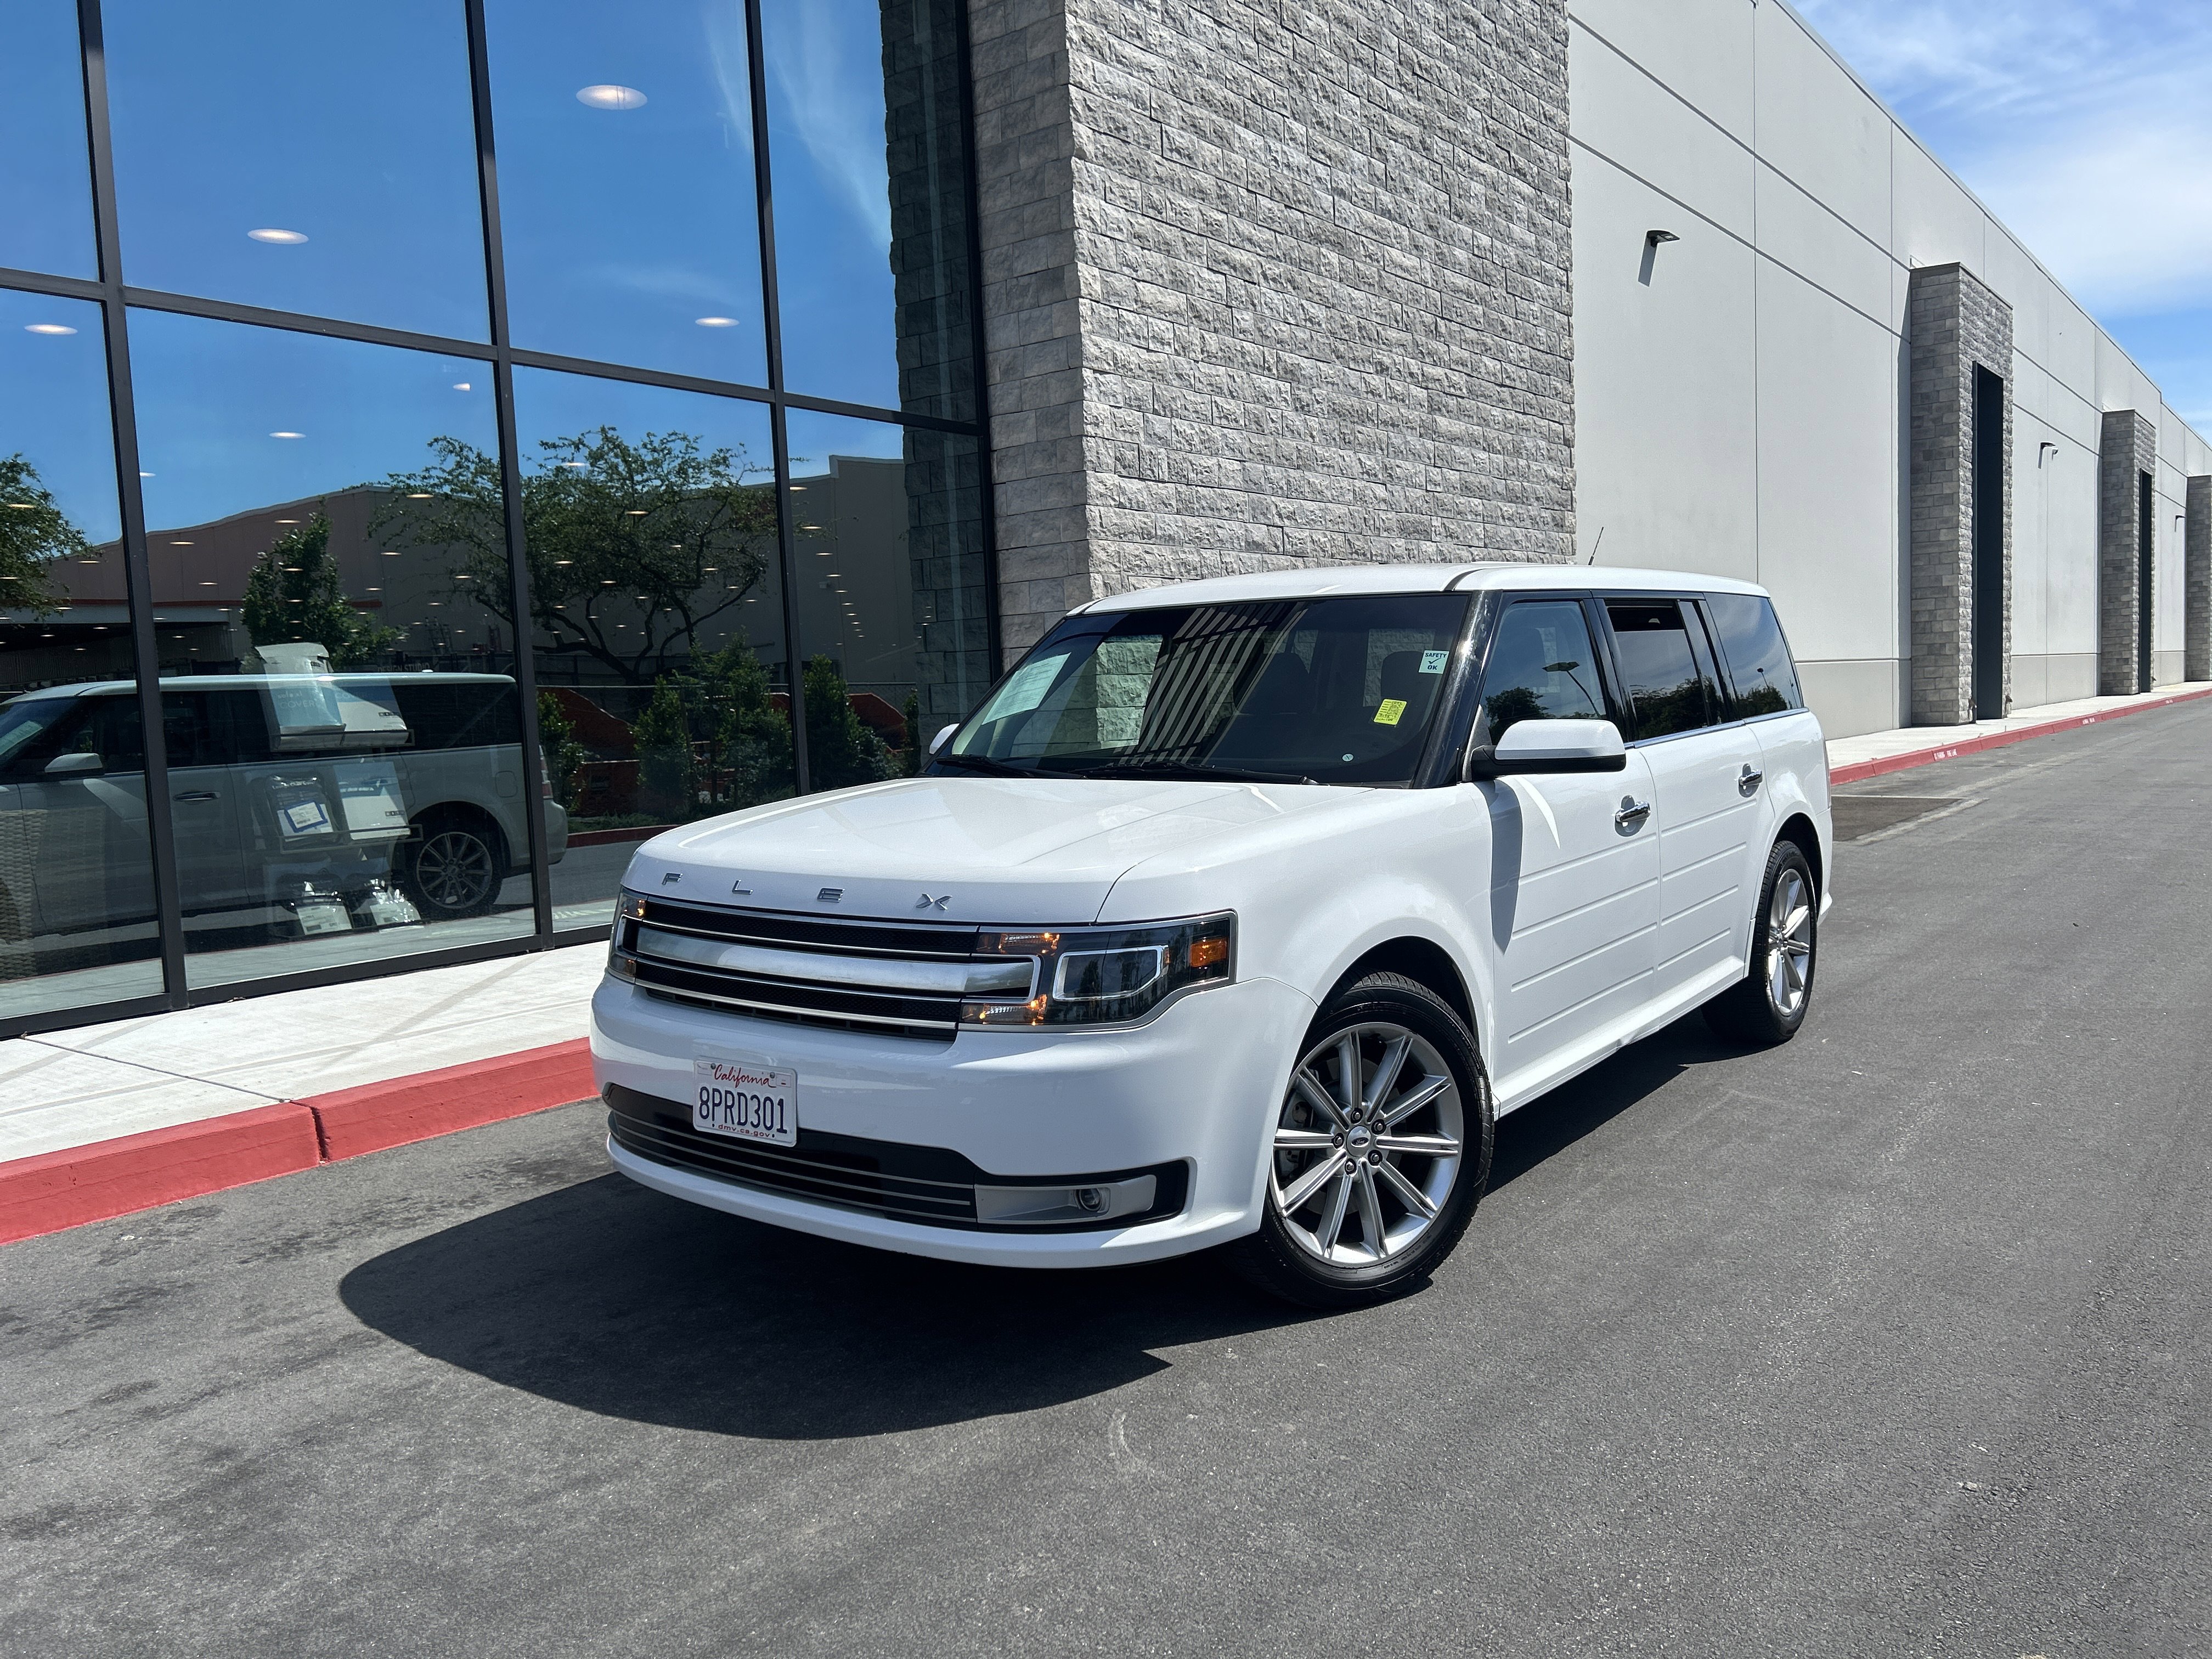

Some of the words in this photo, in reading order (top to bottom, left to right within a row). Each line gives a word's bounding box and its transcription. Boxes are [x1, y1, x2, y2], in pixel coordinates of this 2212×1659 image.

[404, 662, 430, 672] STUDIO
[280, 699, 315, 709] COVER
[662, 872, 952, 910] FLEX
[714, 1064, 776, 1088] California
[699, 1086, 787, 1133] 8PRD301
[718, 1124, 770, 1137] dmv.ca.gov
